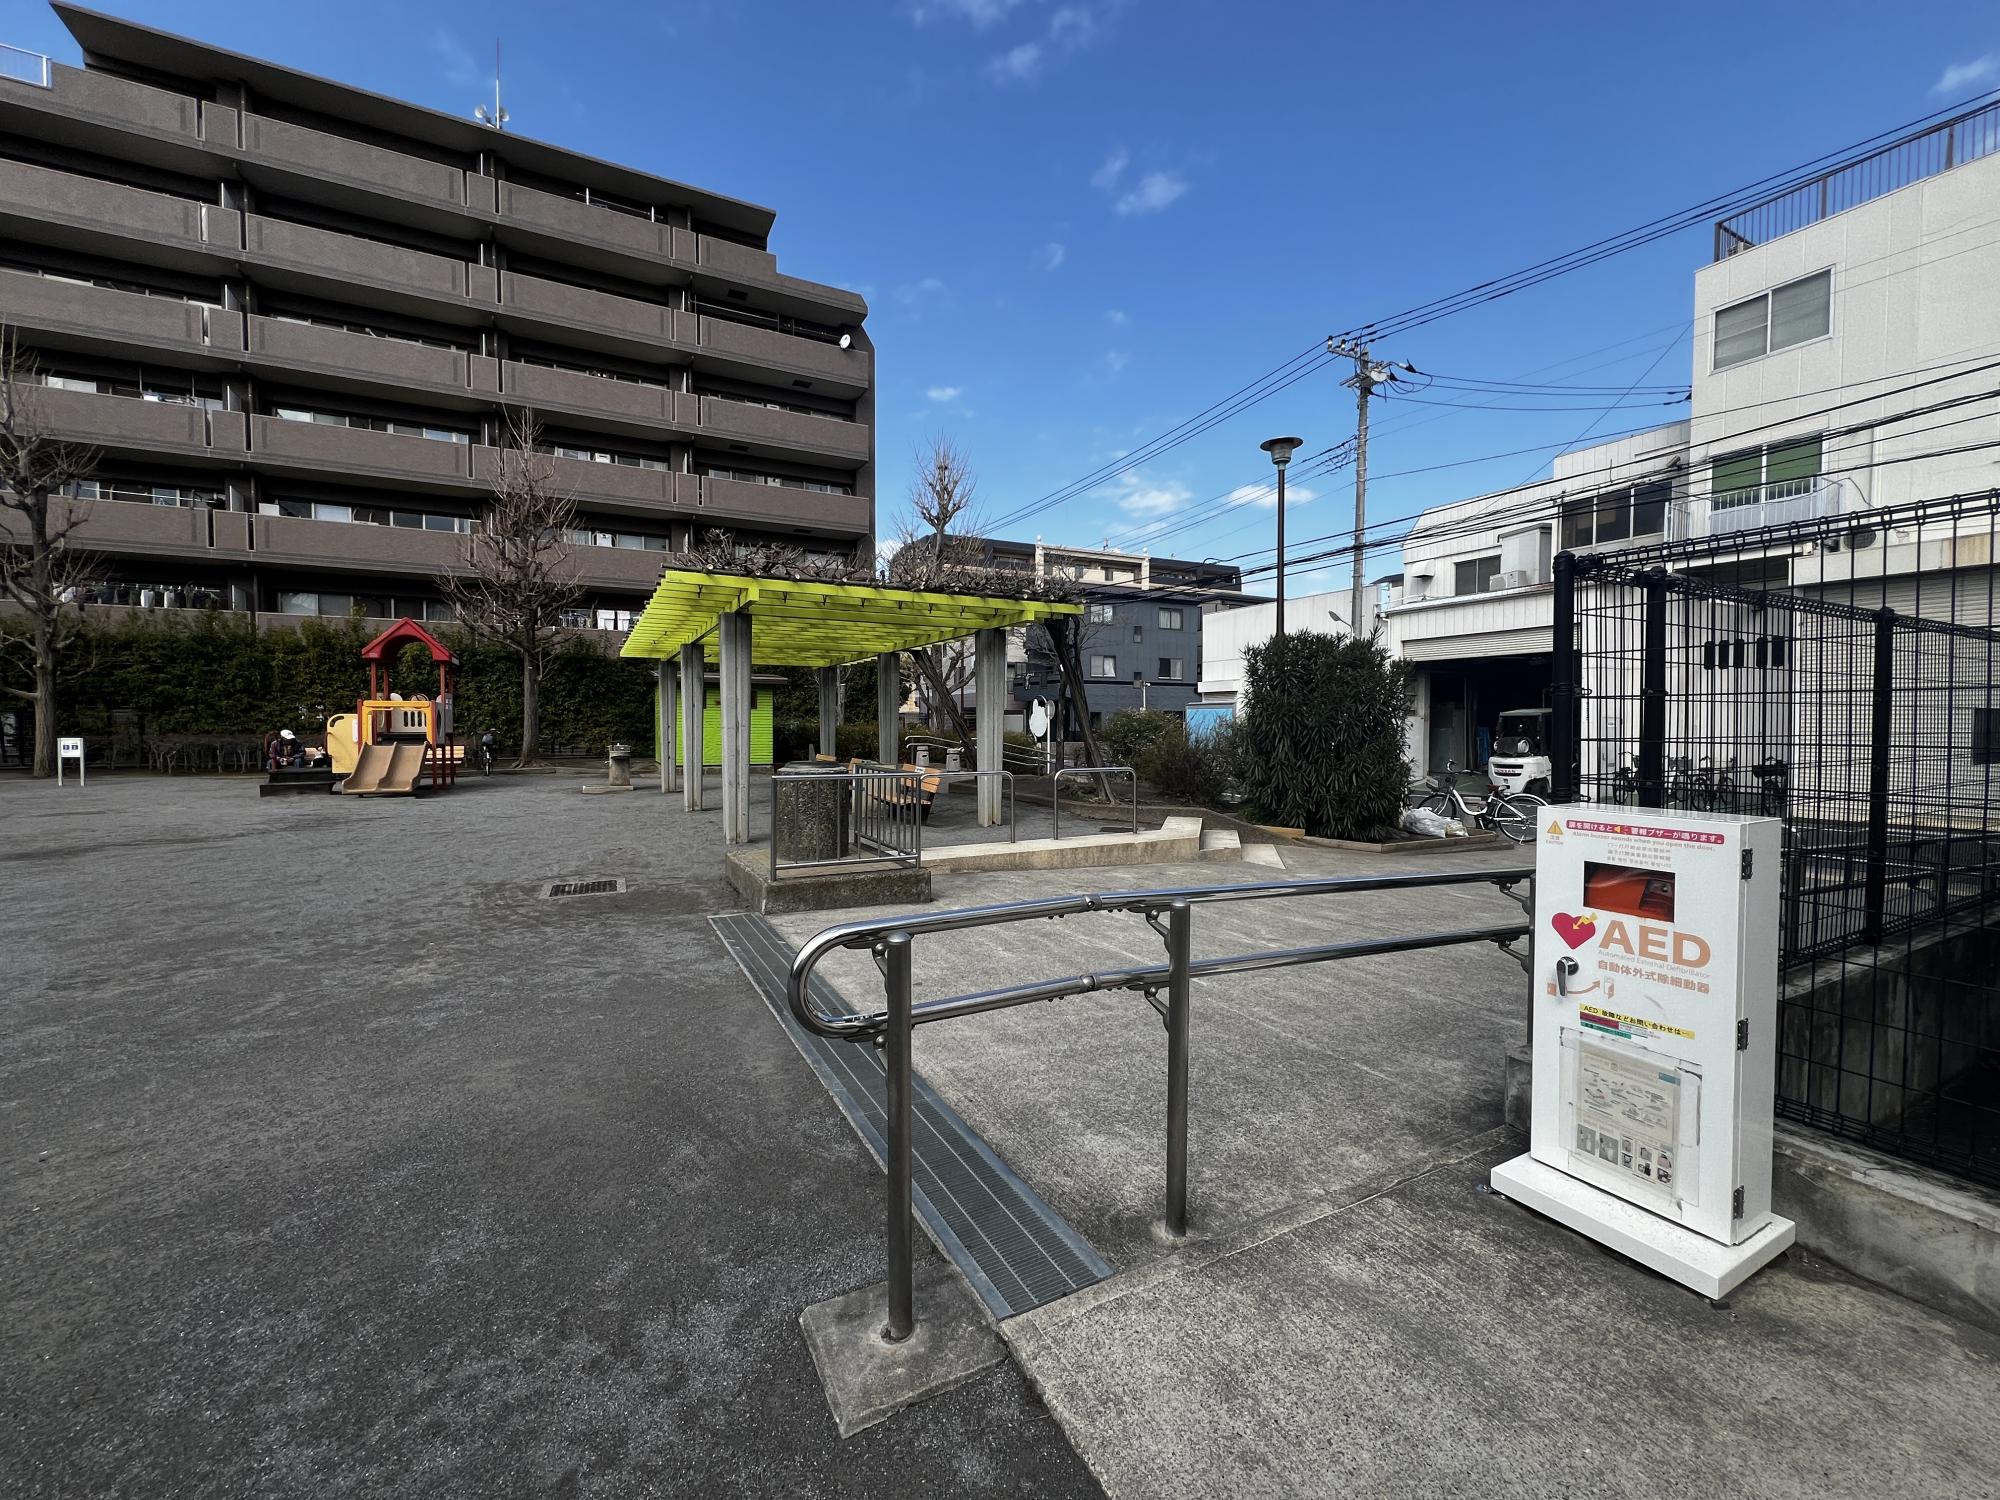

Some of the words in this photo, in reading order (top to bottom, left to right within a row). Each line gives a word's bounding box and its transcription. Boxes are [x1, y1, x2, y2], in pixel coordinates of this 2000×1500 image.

[1599, 920, 1711, 969] AED
[1598, 949, 1635, 963] Automated
[1636, 956, 1665, 969] External
[1598, 960, 1710, 994] 自動体外式除細動器
[1583, 1005, 1599, 1014] AED
